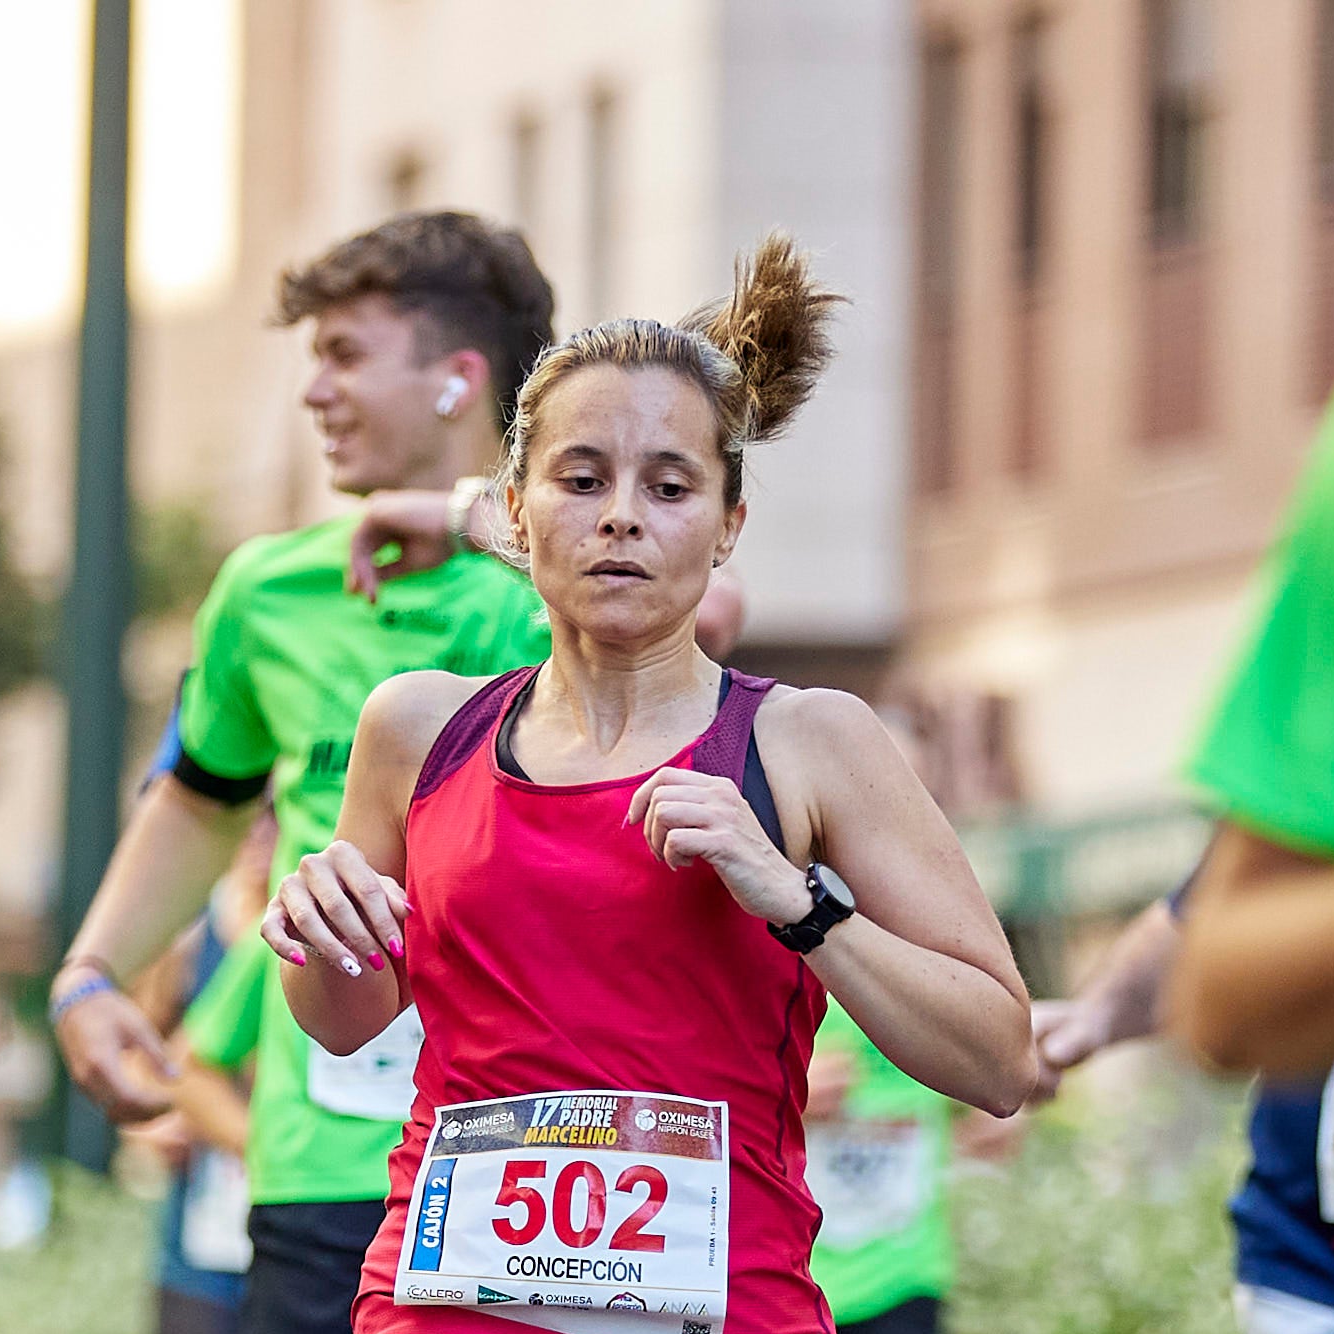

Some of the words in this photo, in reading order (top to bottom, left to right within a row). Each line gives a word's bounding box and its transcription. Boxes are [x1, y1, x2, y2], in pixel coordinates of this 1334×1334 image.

[463, 1111, 515, 1130] OXIMESA
[530, 1098, 562, 1128] 17
[560, 1096, 618, 1110] MEMORIAL
[558, 1109, 613, 1128] PADRE
[658, 1111, 715, 1130] OXIMESA
[523, 1125, 618, 1146] MARCELINO
[657, 1124, 689, 1136] NIPPON
[431, 1176, 448, 1189] 2
[491, 1159, 669, 1254] 502
[421, 1194, 446, 1248] CAJÓN
[506, 1255, 643, 1283] CONCEPCIÓN
[411, 1287, 464, 1300] CALERO
[545, 1294, 593, 1305] OXIMESA
